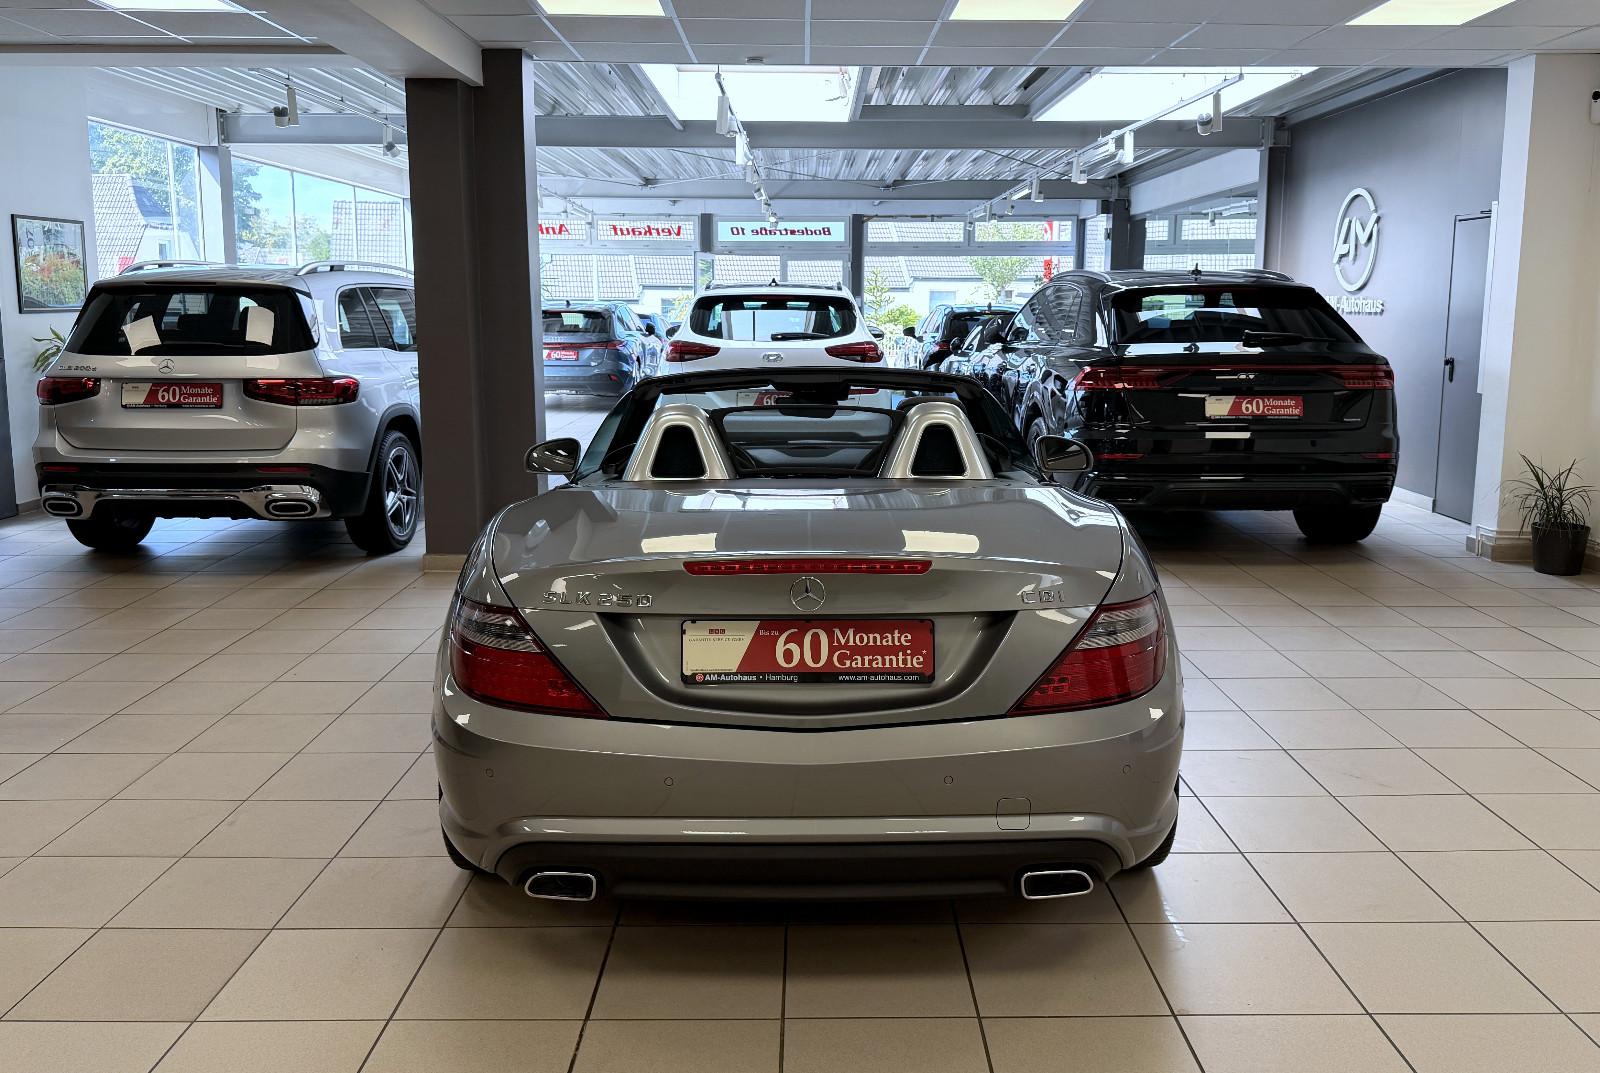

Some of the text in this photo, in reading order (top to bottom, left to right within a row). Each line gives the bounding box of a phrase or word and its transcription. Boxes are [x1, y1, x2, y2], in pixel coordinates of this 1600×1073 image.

[158, 386, 180, 403] 60
[180, 386, 213, 394] Monate
[1241, 399, 1263, 414] 60
[1264, 398, 1296, 406] Monate
[542, 591, 592, 605] SLK
[832, 628, 912, 646] Monate
[775, 628, 829, 668] 60
[705, 673, 799, 683] AM-Autohaus Hamburg
